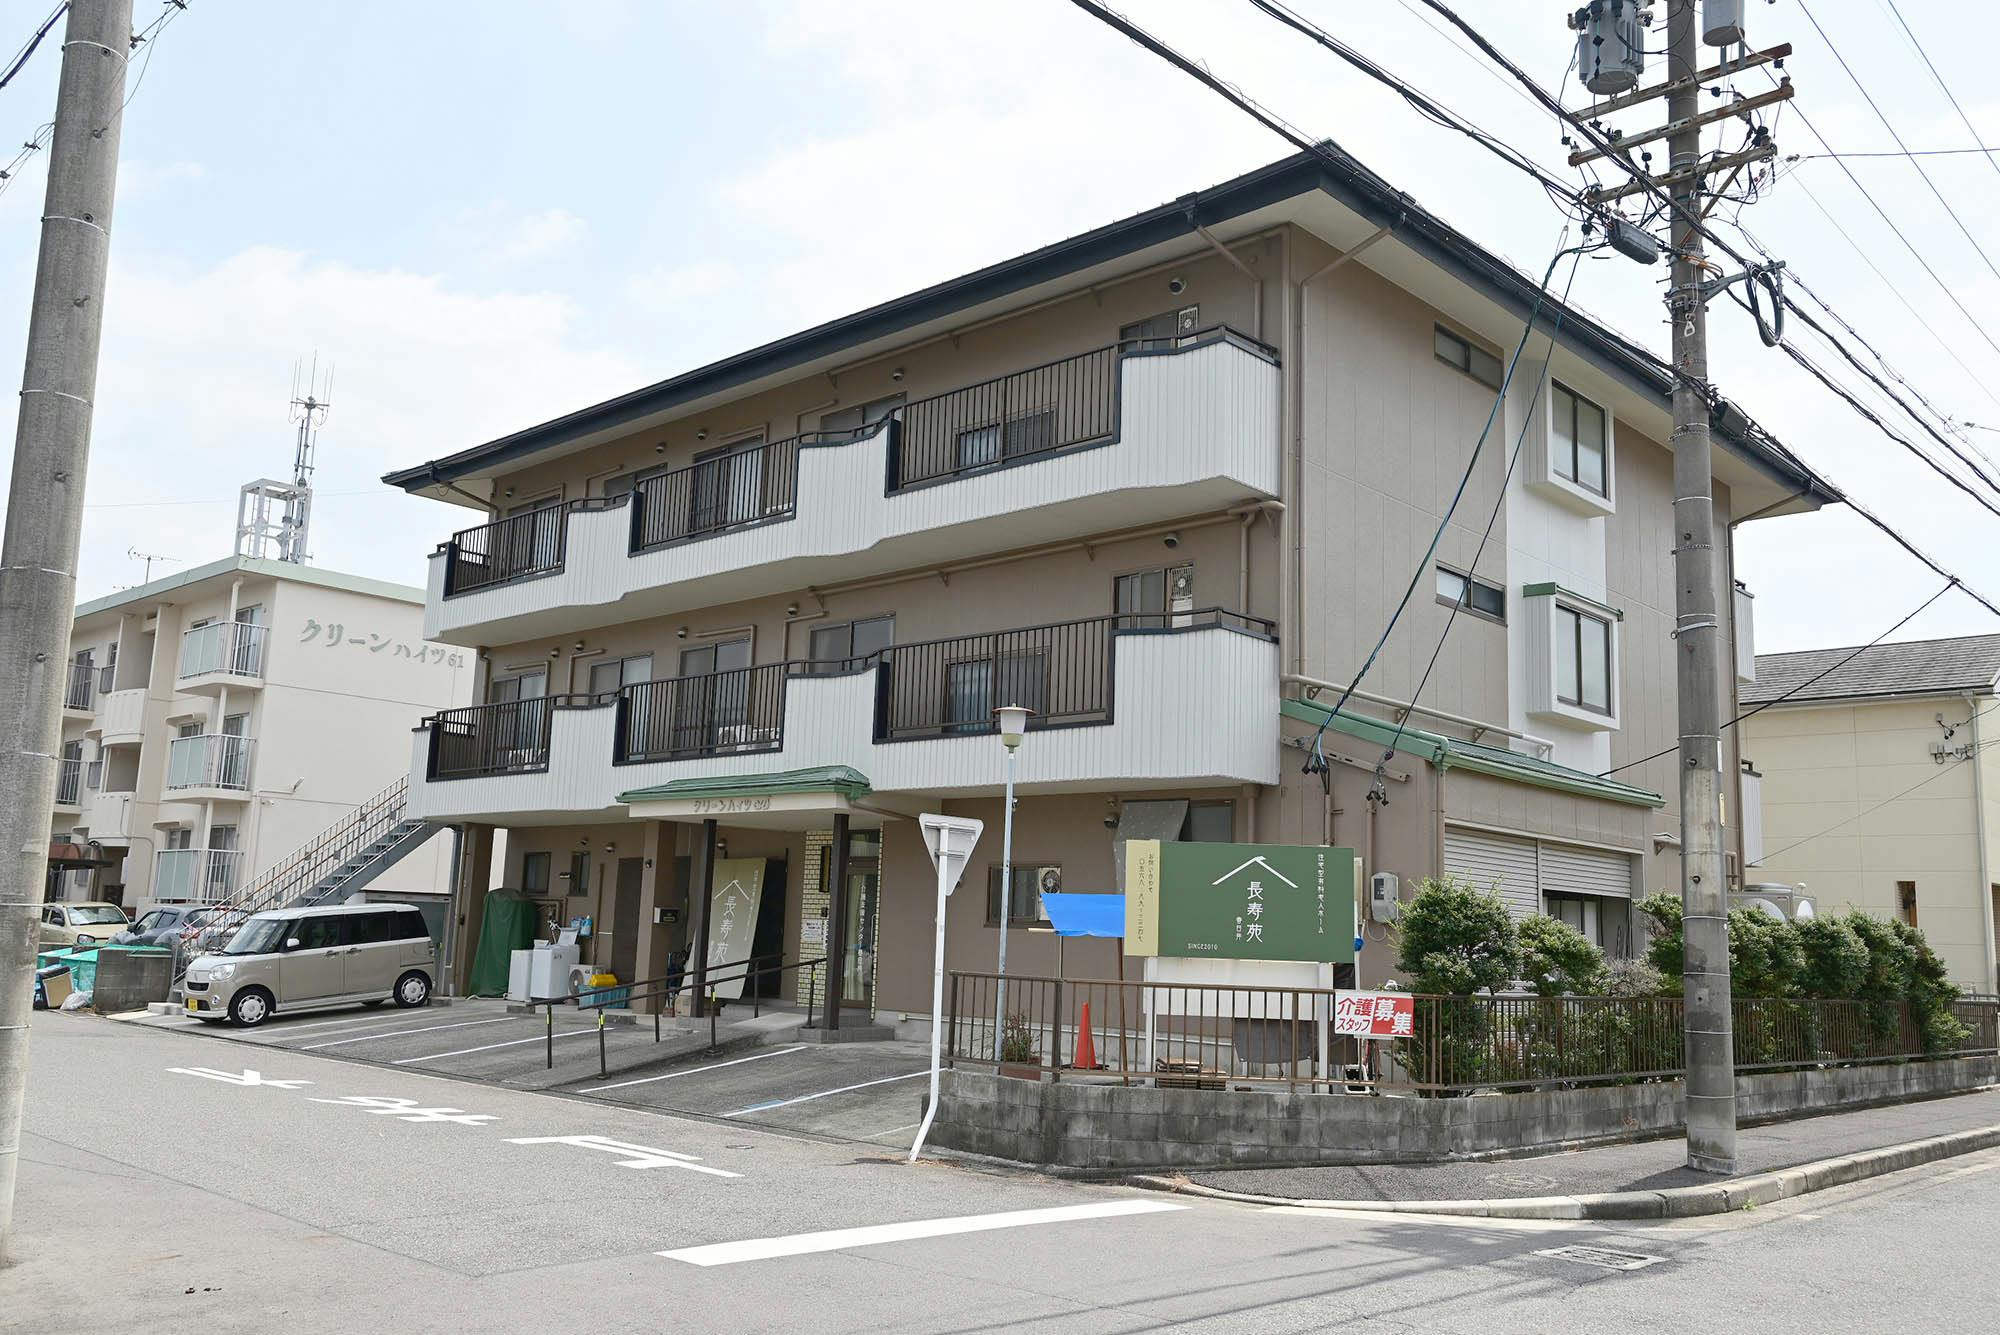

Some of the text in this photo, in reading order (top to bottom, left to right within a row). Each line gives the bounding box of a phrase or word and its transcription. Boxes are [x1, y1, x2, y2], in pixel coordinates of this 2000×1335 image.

[300, 618, 464, 669] クリーンハイツ61
[713, 895, 736, 963] 長寿苑
[1246, 881, 1264, 943] 長寿苑
[1335, 1017, 1372, 1032] スタッフ
[1336, 997, 1375, 1017] 介護
[1374, 998, 1413, 1035] 募集
